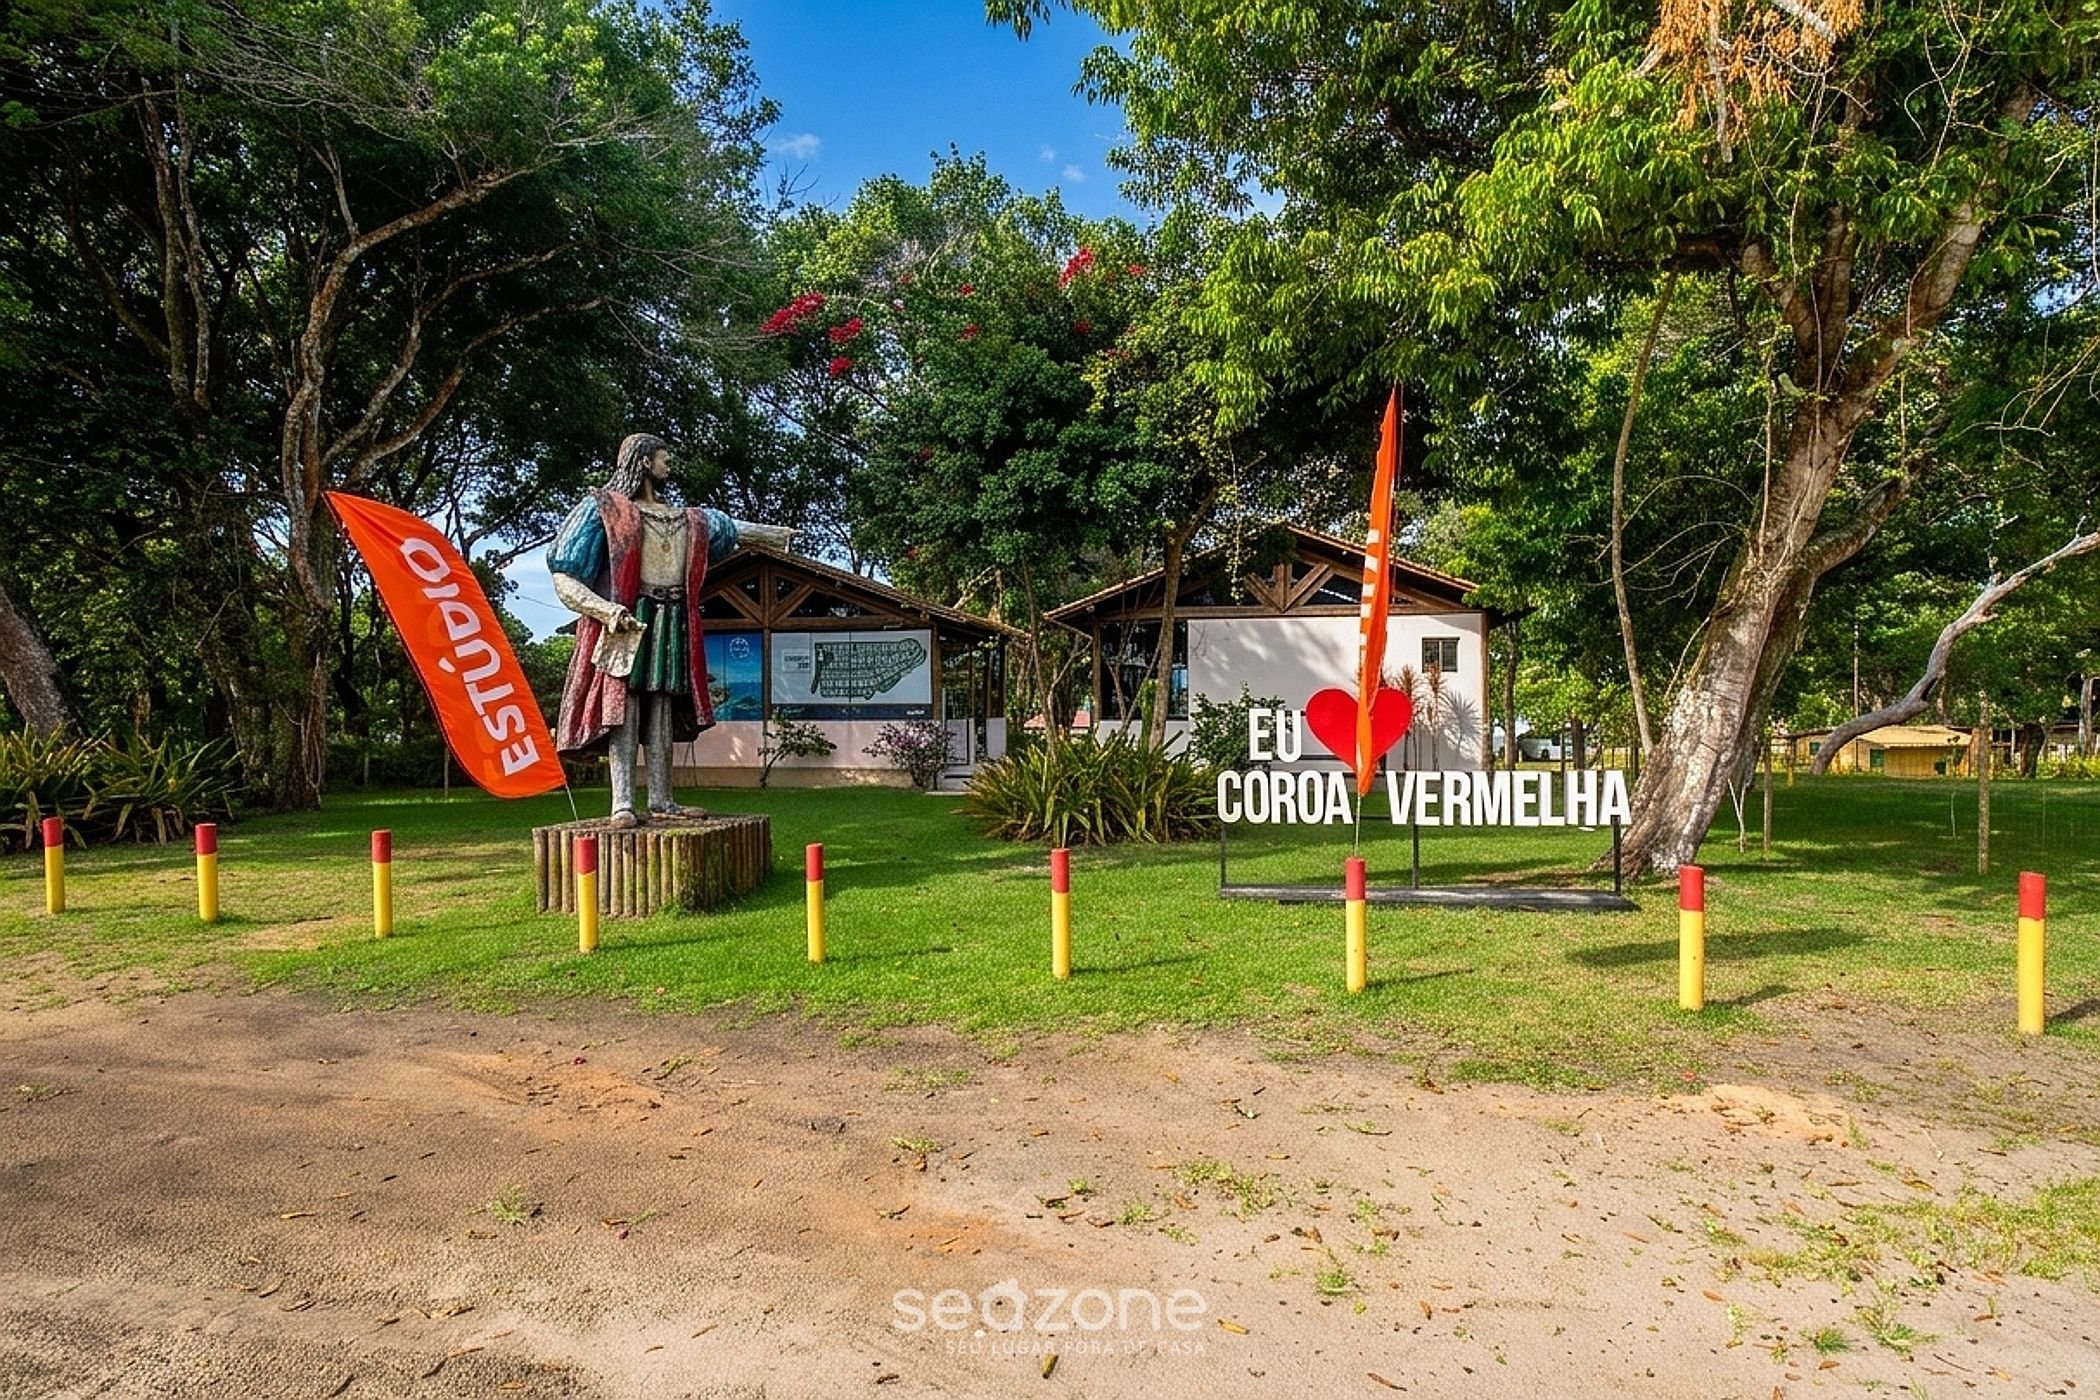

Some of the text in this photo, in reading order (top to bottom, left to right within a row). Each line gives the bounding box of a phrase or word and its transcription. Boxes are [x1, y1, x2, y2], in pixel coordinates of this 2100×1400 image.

[400, 537, 541, 777] ESTÚDIO
[1249, 707, 1302, 762] EU
[1217, 769, 1632, 828] COROA VERMELHA
